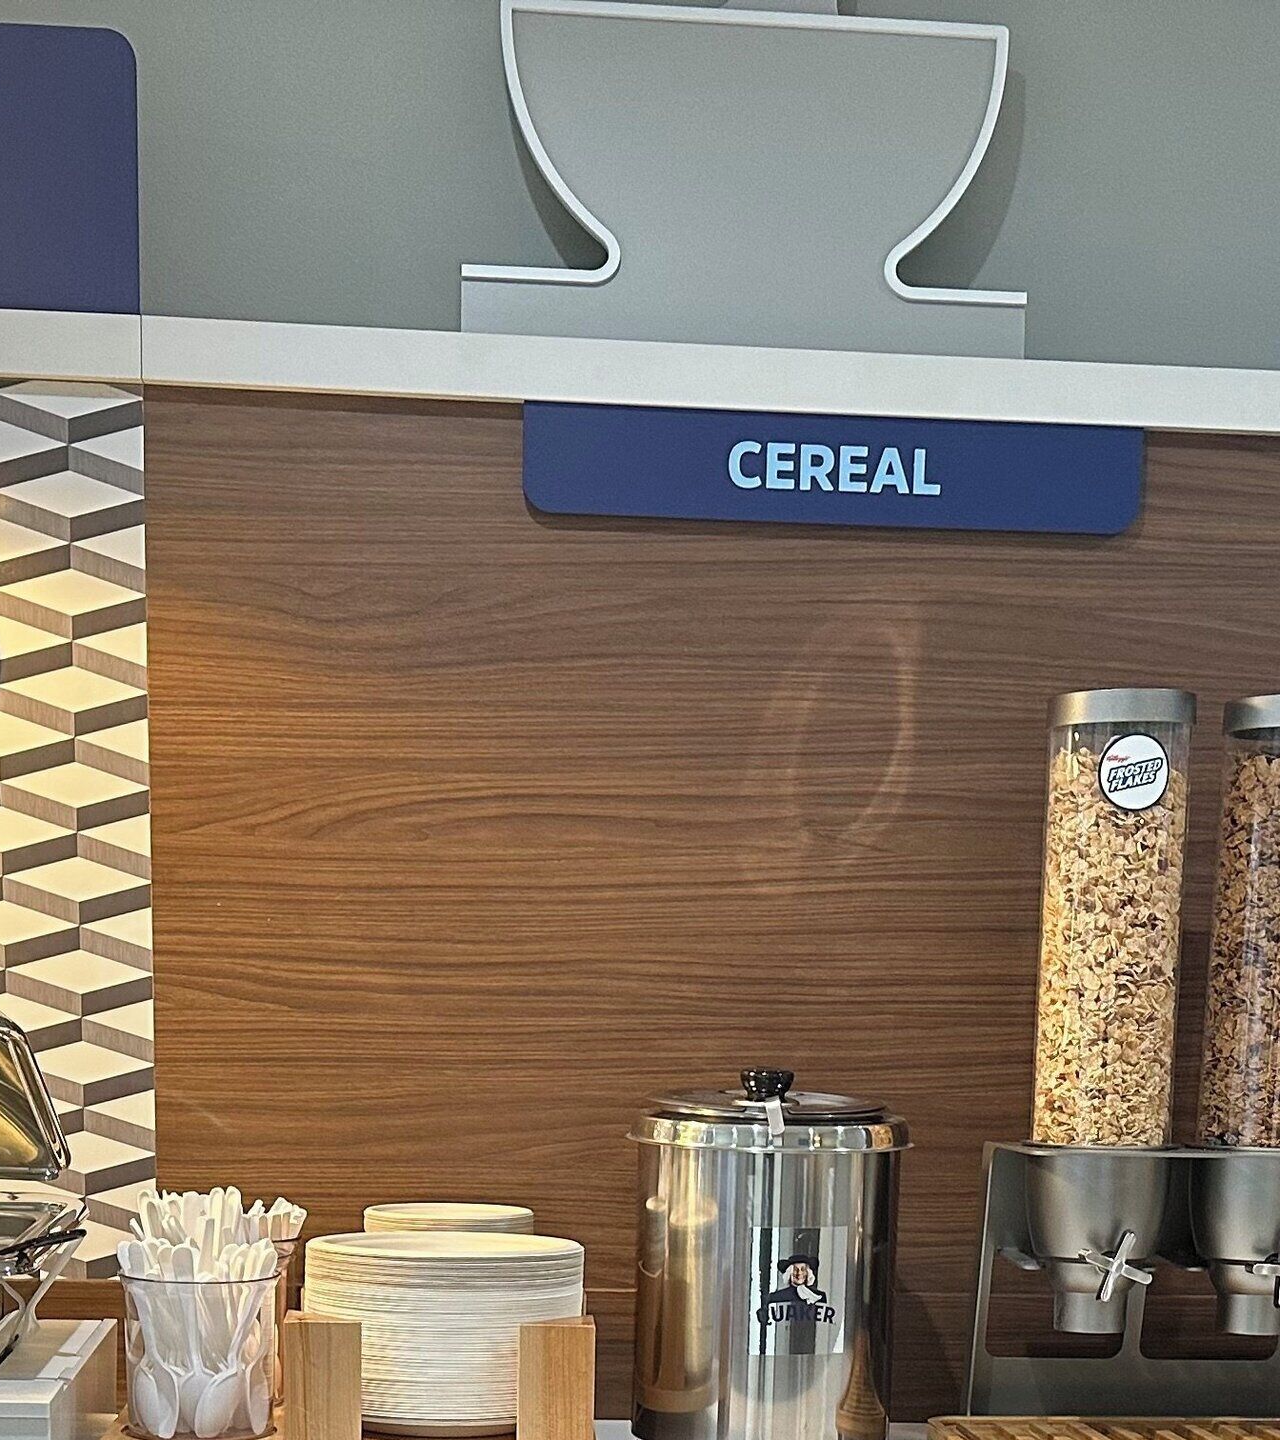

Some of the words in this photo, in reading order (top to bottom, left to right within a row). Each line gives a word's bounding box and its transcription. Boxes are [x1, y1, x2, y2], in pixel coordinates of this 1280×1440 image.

[727, 440, 942, 496] CEREAL
[1108, 757, 1163, 782] FROSTED
[1109, 771, 1157, 792] FLAKES
[756, 1304, 837, 1325] QUAKER
